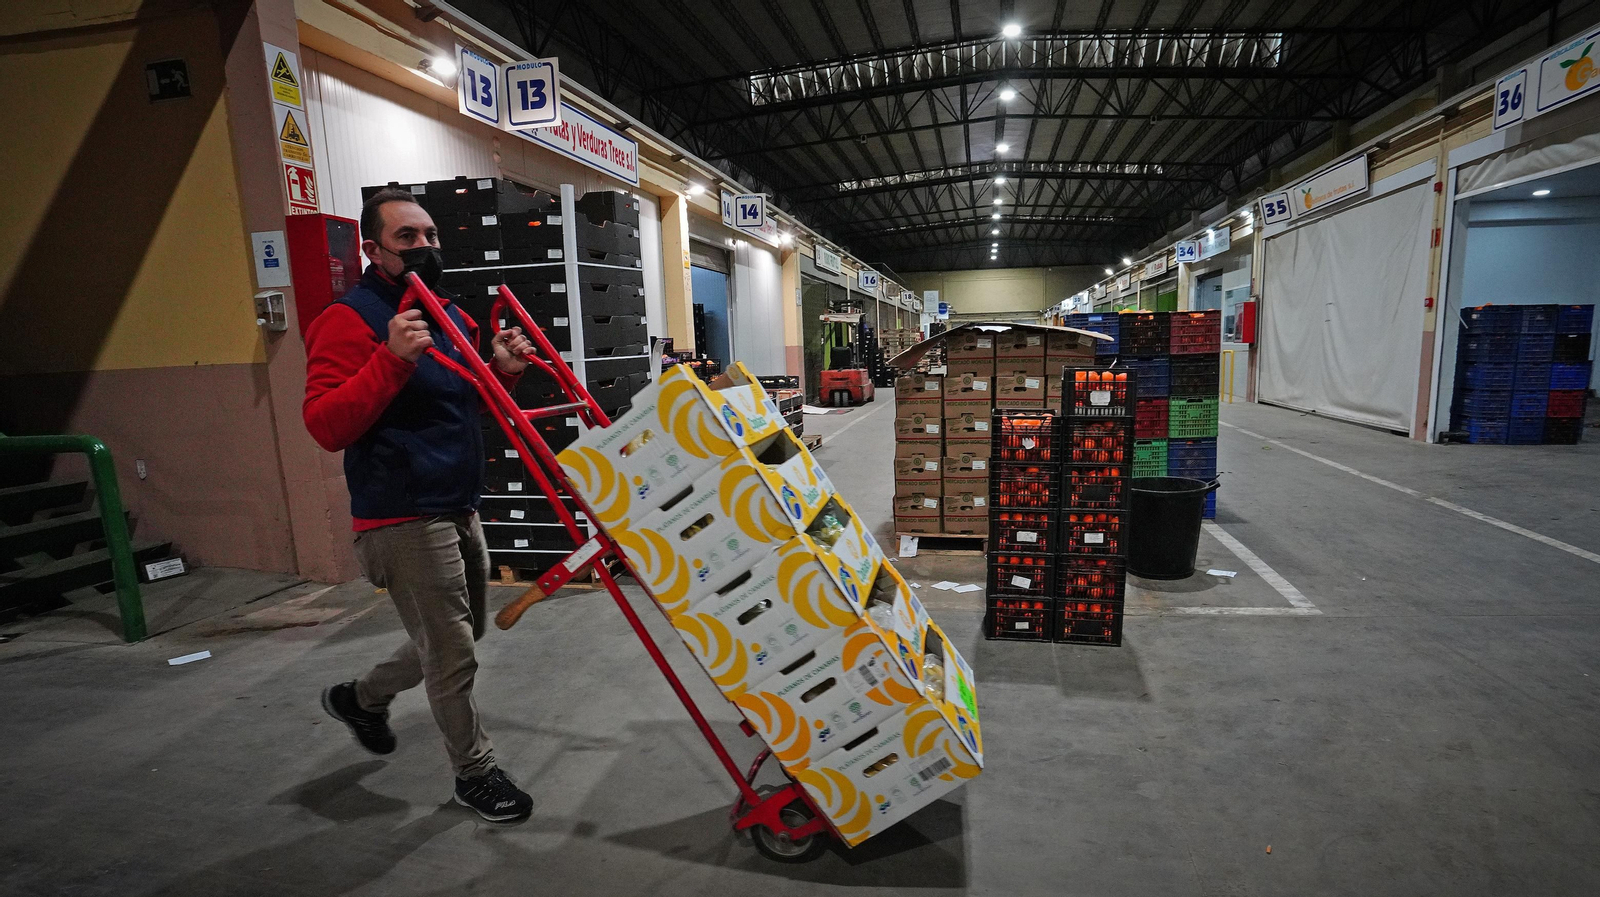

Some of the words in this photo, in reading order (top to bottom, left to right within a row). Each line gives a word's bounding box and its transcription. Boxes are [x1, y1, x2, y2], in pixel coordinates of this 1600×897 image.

[516, 62, 543, 70] MODULO
[467, 68, 493, 108] 13
[517, 79, 547, 111] 13
[1498, 83, 1522, 117] 36
[545, 120, 569, 142] rutas
[571, 125, 576, 151] y
[577, 122, 608, 160] Verduras
[608, 139, 625, 168] Trece
[723, 201, 731, 218] 14
[741, 204, 759, 219] 14
[1265, 199, 1287, 218] 35
[1179, 245, 1195, 257] 34
[865, 276, 876, 285] 16
[803, 672, 812, 680] DE
